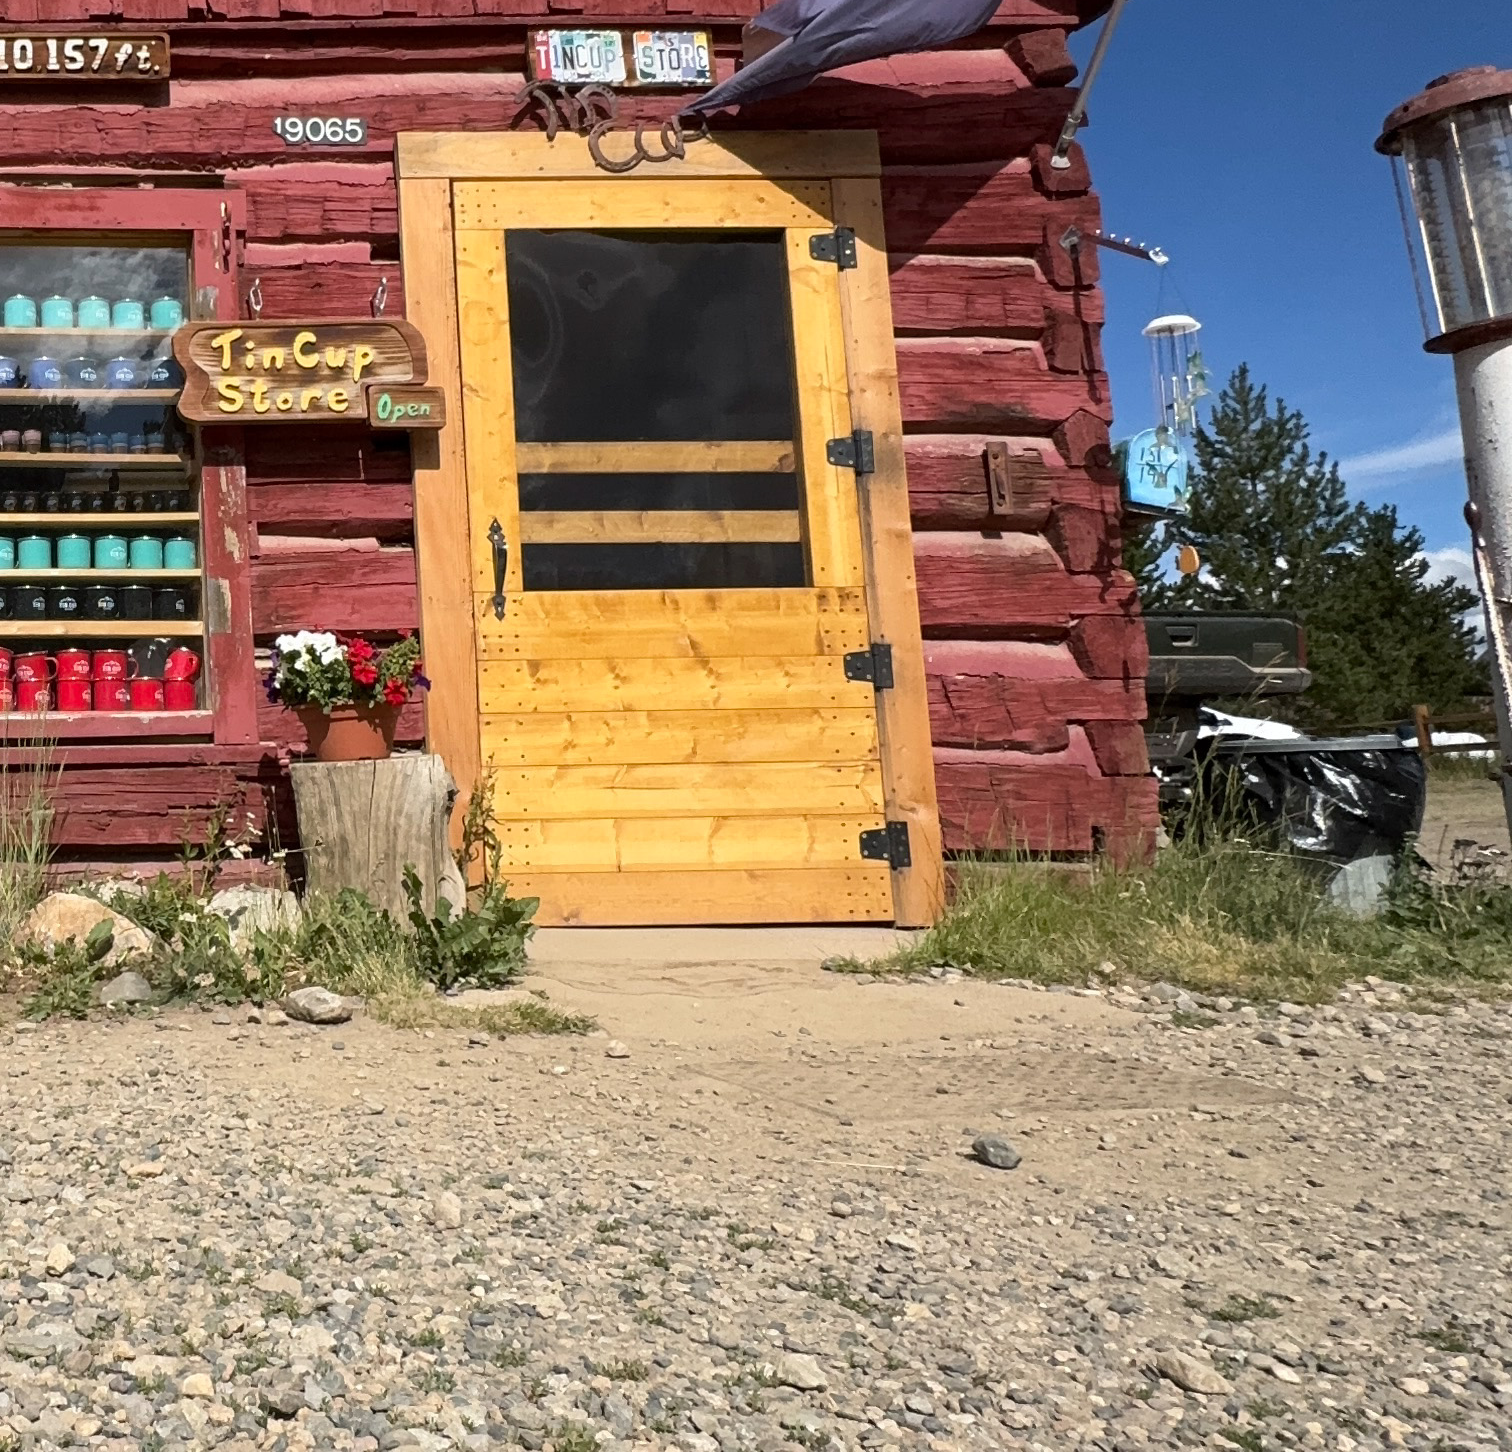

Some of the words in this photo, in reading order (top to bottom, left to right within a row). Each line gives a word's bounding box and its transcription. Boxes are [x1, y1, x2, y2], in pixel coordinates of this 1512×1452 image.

[114, 42, 160, 72] ft.
[642, 44, 707, 71] STORE
[274, 117, 363, 142] 19065
[217, 377, 349, 413] Store
[377, 393, 431, 423] Open
